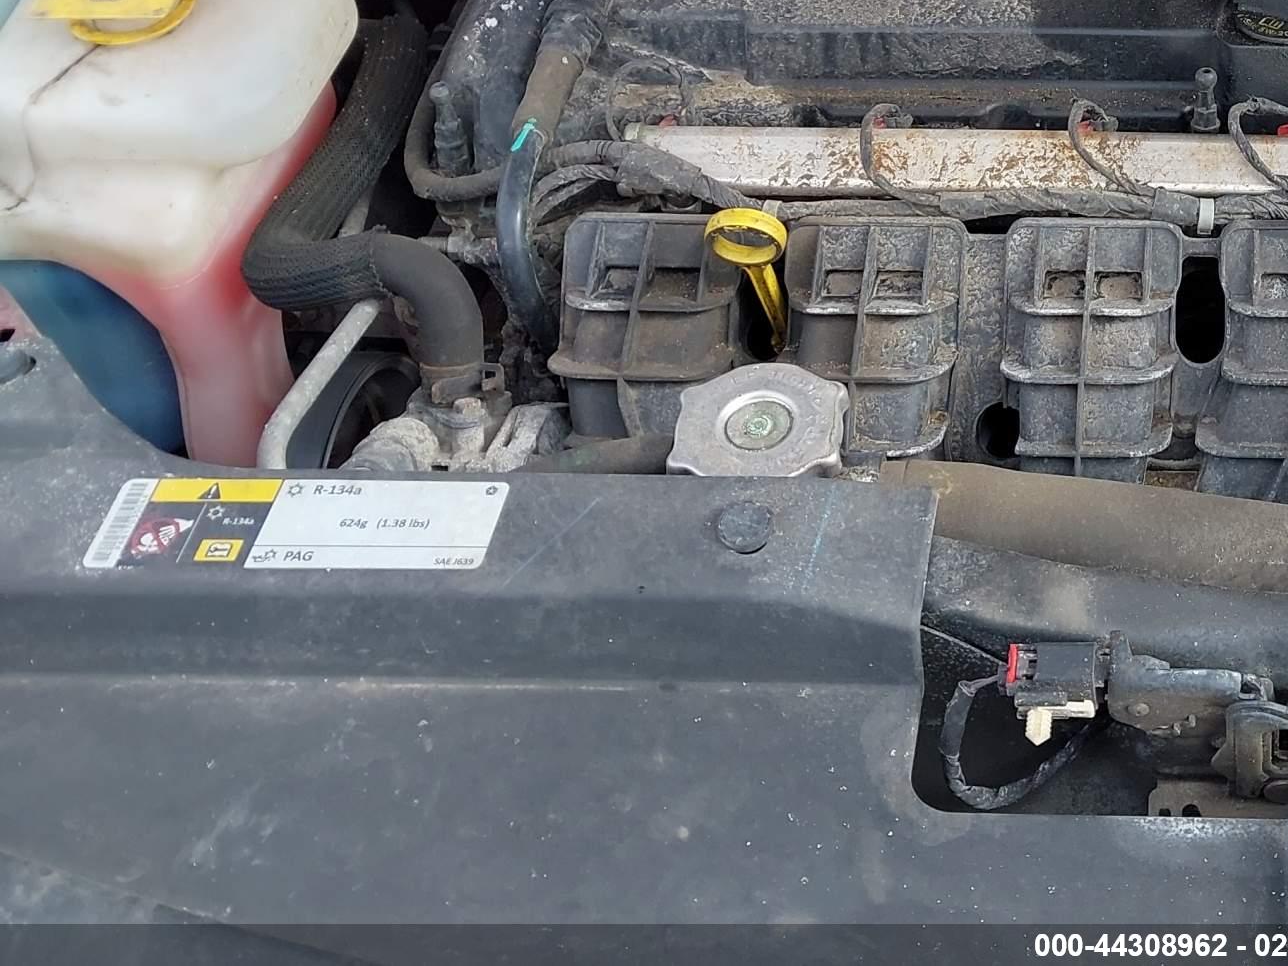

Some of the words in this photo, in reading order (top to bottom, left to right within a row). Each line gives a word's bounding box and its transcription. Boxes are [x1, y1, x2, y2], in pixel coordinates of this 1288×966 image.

[313, 484, 362, 495] R-134a
[222, 517, 255, 526] R-134a
[339, 518, 368, 530] 624g
[376, 518, 407, 530] (1.38
[408, 518, 430, 530] lbs)
[282, 550, 314, 562] PAG
